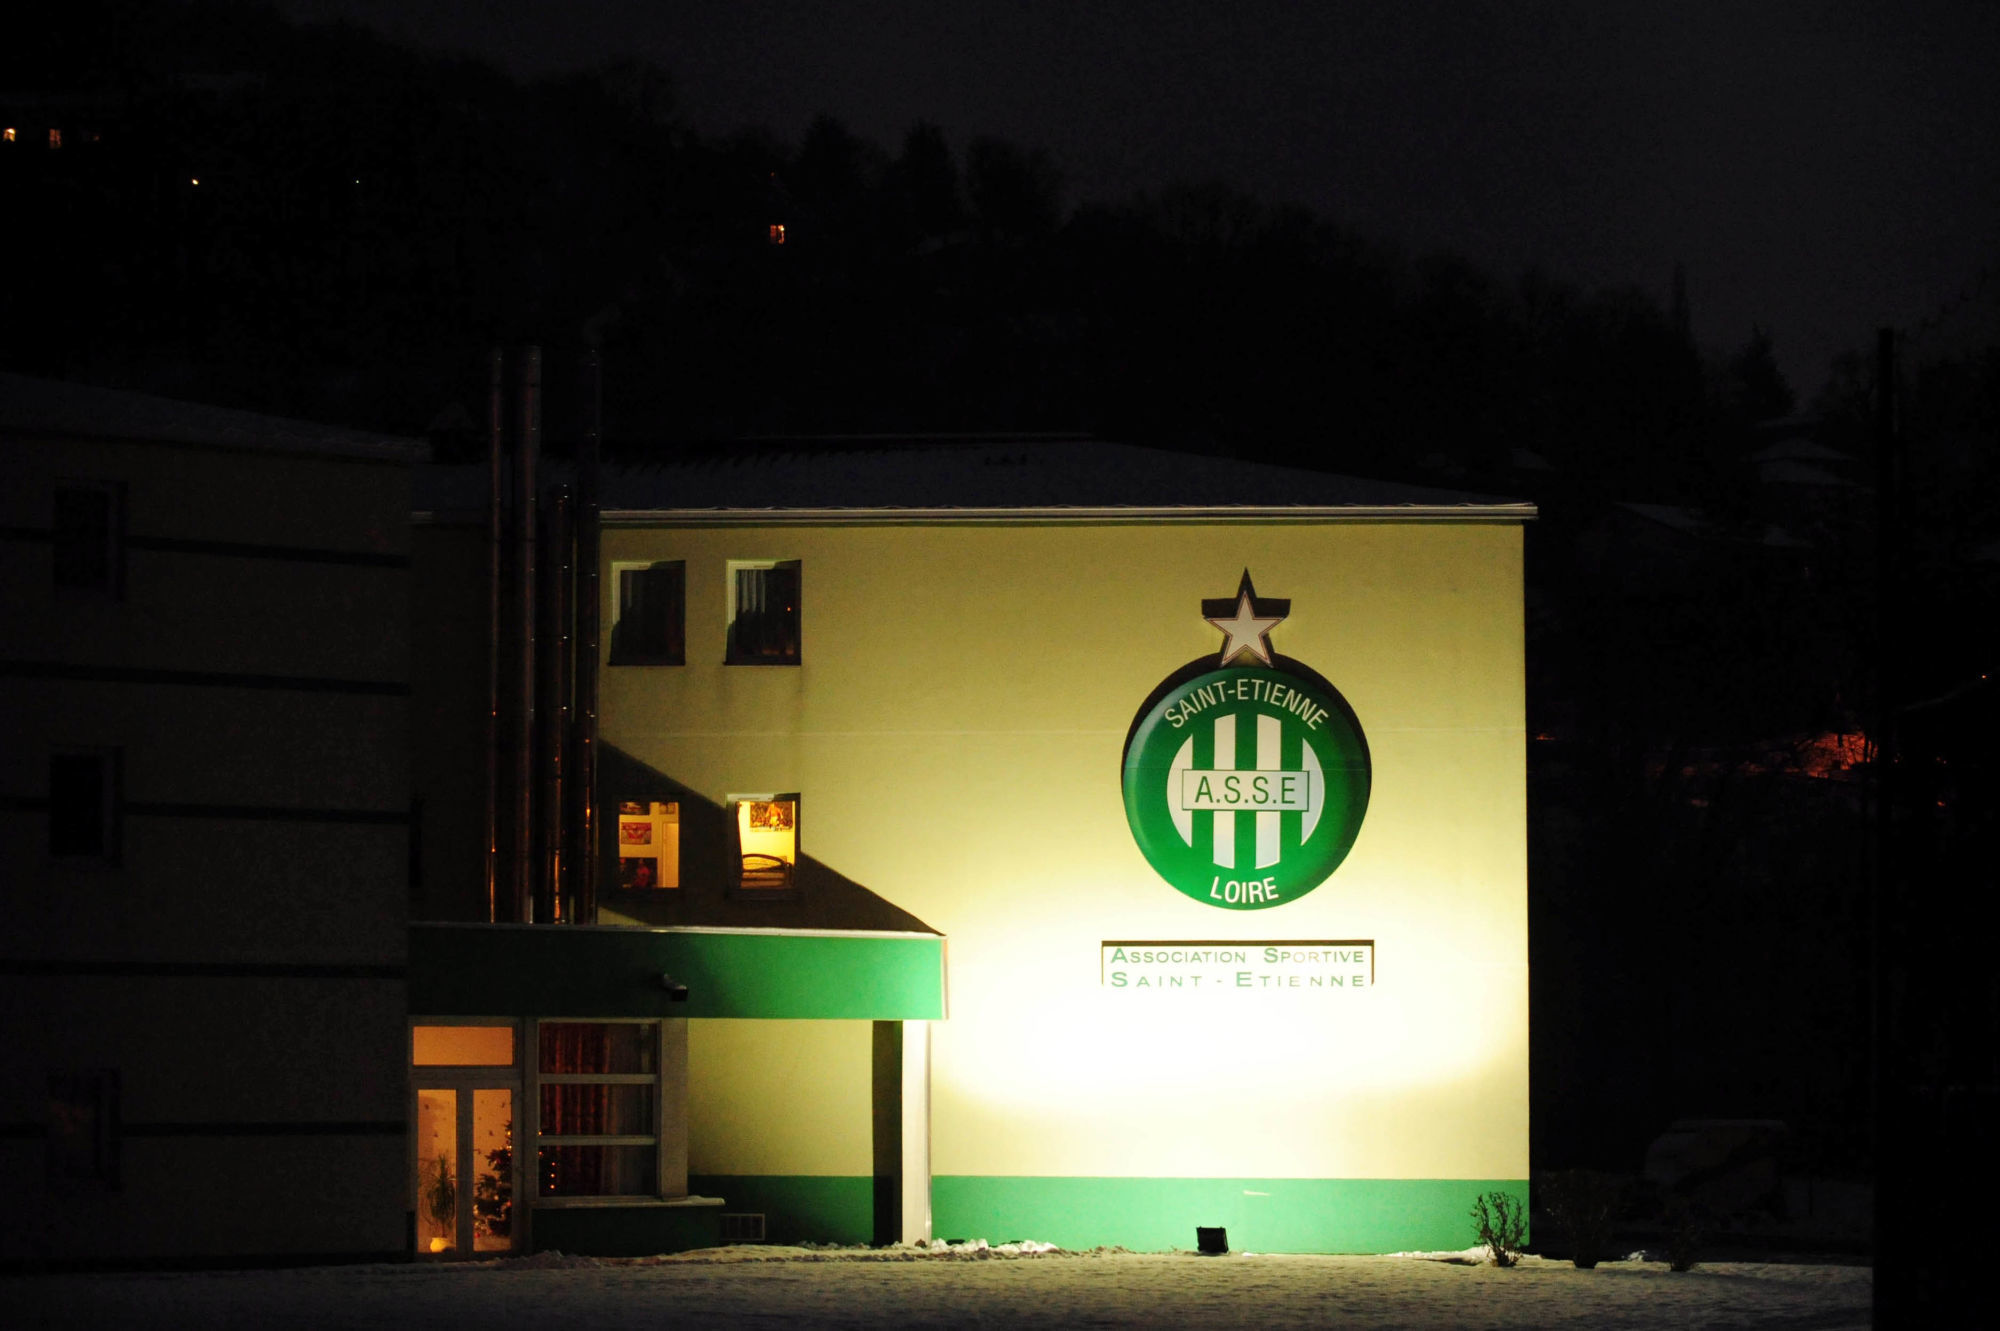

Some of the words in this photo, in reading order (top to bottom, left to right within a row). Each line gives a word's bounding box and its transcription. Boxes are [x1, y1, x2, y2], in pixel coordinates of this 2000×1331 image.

[1165, 679, 1328, 730] SAINT-ETIENNE
[1194, 776, 1296, 804] A.S.S.E
[1210, 876, 1279, 903] LOIRE
